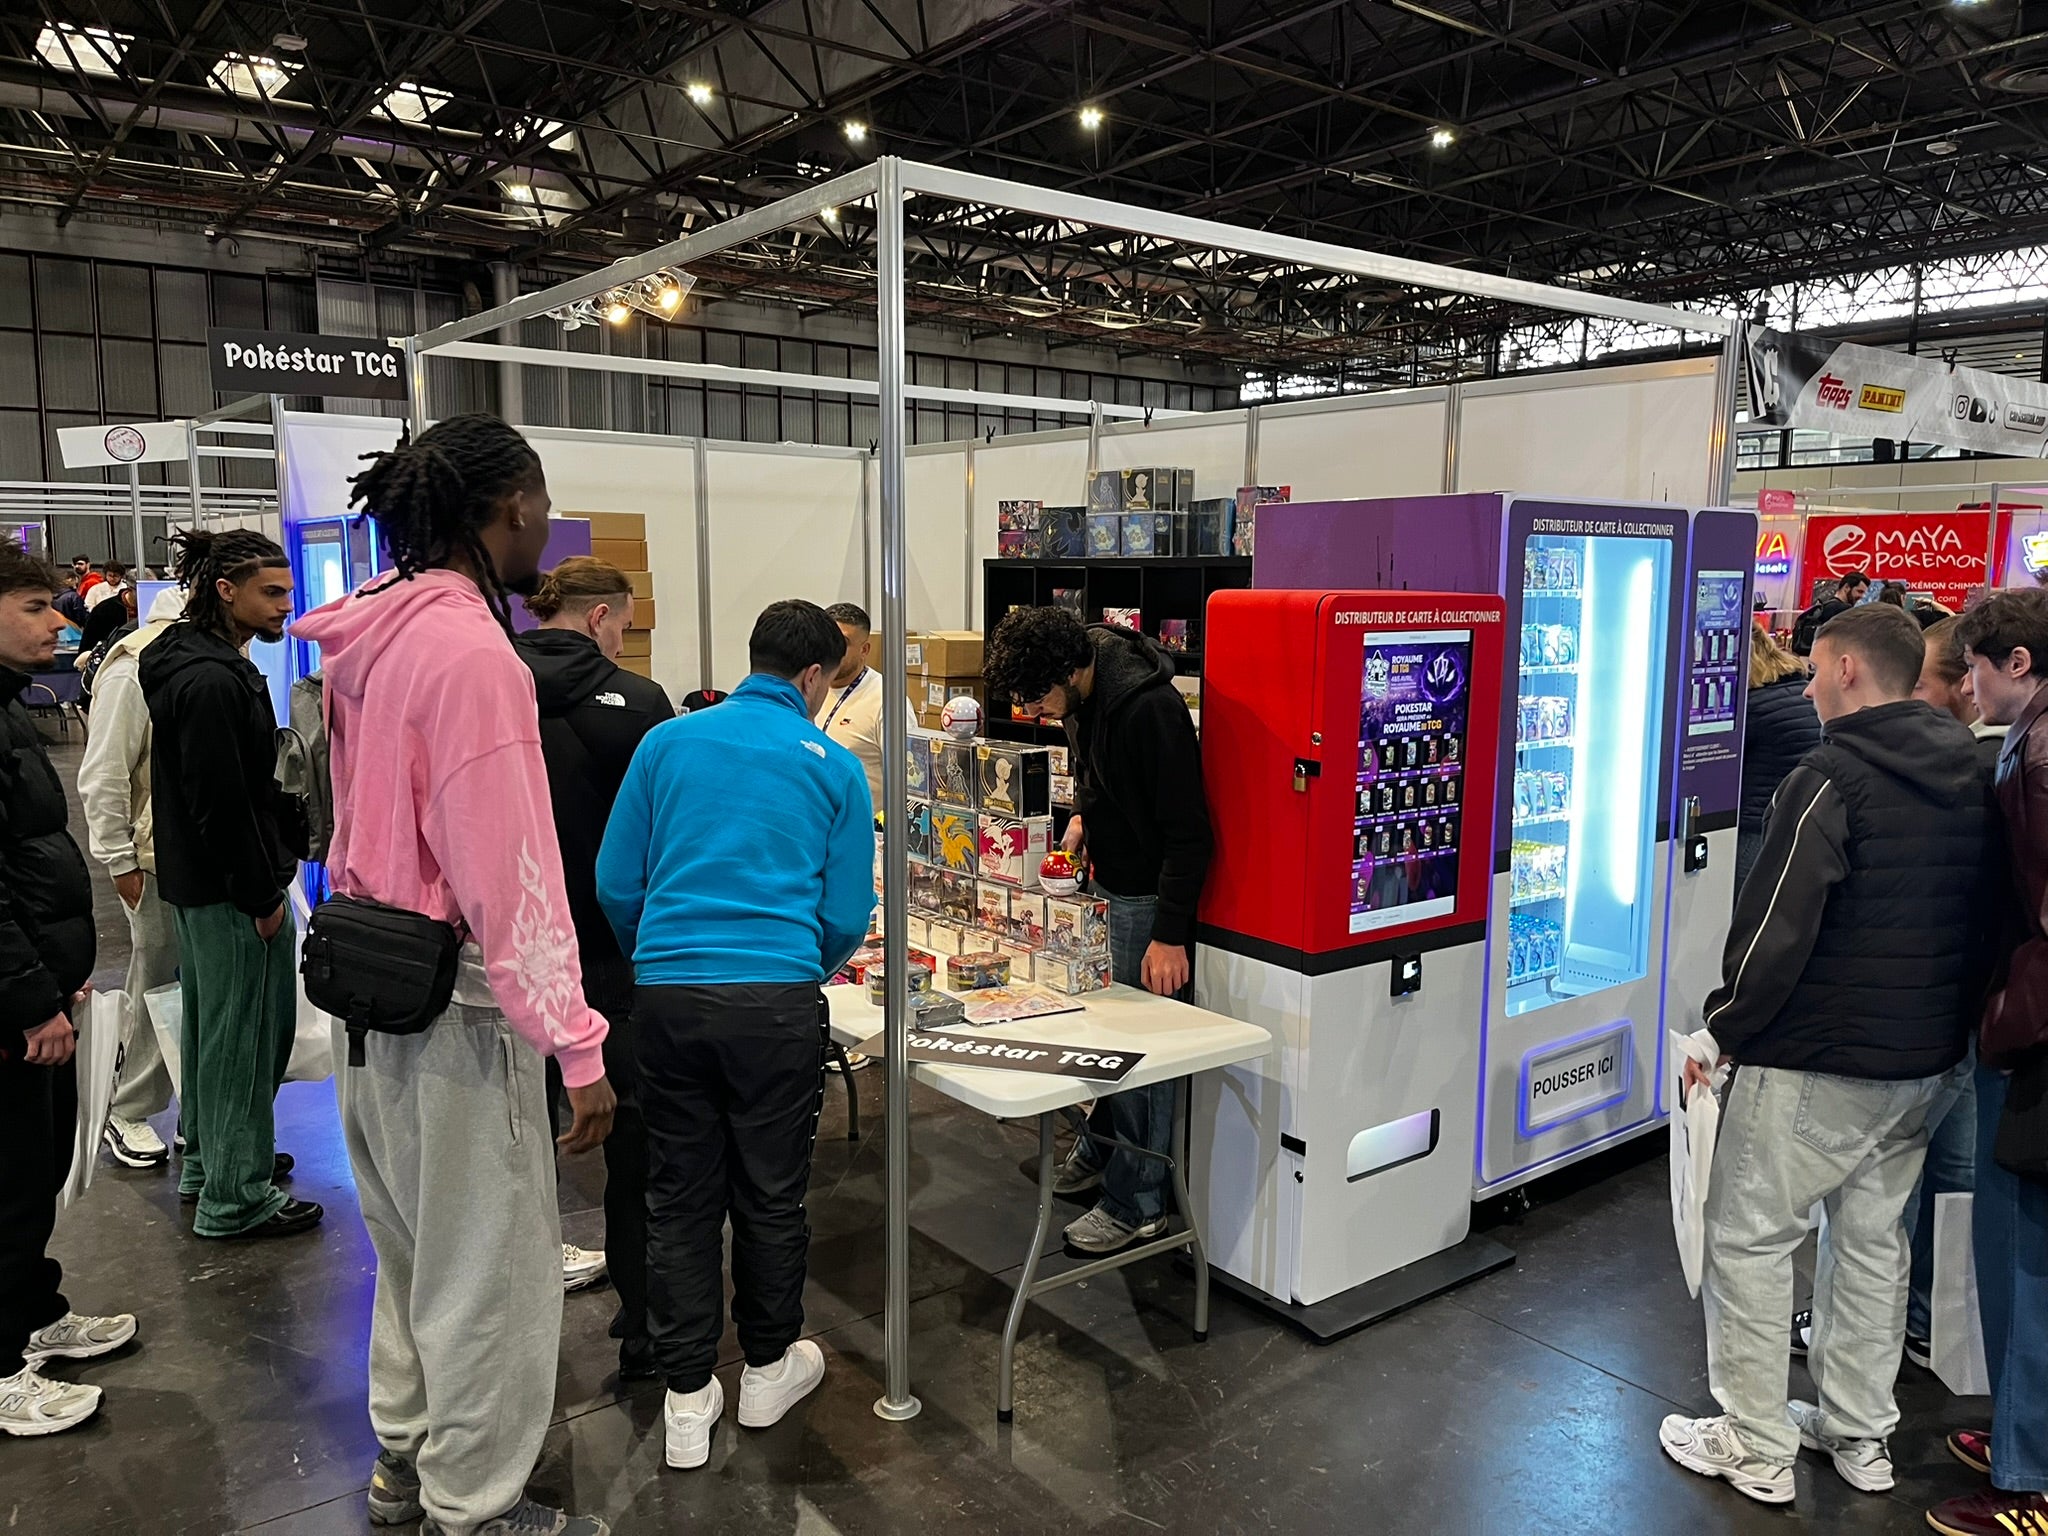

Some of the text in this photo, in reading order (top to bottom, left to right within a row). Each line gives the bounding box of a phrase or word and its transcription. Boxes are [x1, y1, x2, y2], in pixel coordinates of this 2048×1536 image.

[223, 342, 398, 378] Pokéstar TCG
[1862, 389, 1903, 407] PANINI
[1533, 518, 1674, 536] DISTRIBUTEUR DE CARTE À COLLECTIONNER
[1756, 533, 1786, 559] YA
[1875, 524, 1962, 551] MAYA
[1875, 552, 1987, 573] POKEMON
[1905, 581, 1946, 590] OKÉMON
[1335, 608, 1500, 624] DISTRIBUTEUR DE CARTE À COLLECTIONNER
[1391, 654, 1423, 664] ROYAUME
[1383, 721, 1421, 734] ROYAUME
[1427, 720, 1442, 730] TCG
[1057, 1051, 1124, 1070] TCG
[1533, 1055, 1613, 1099] POUSSER ICI
